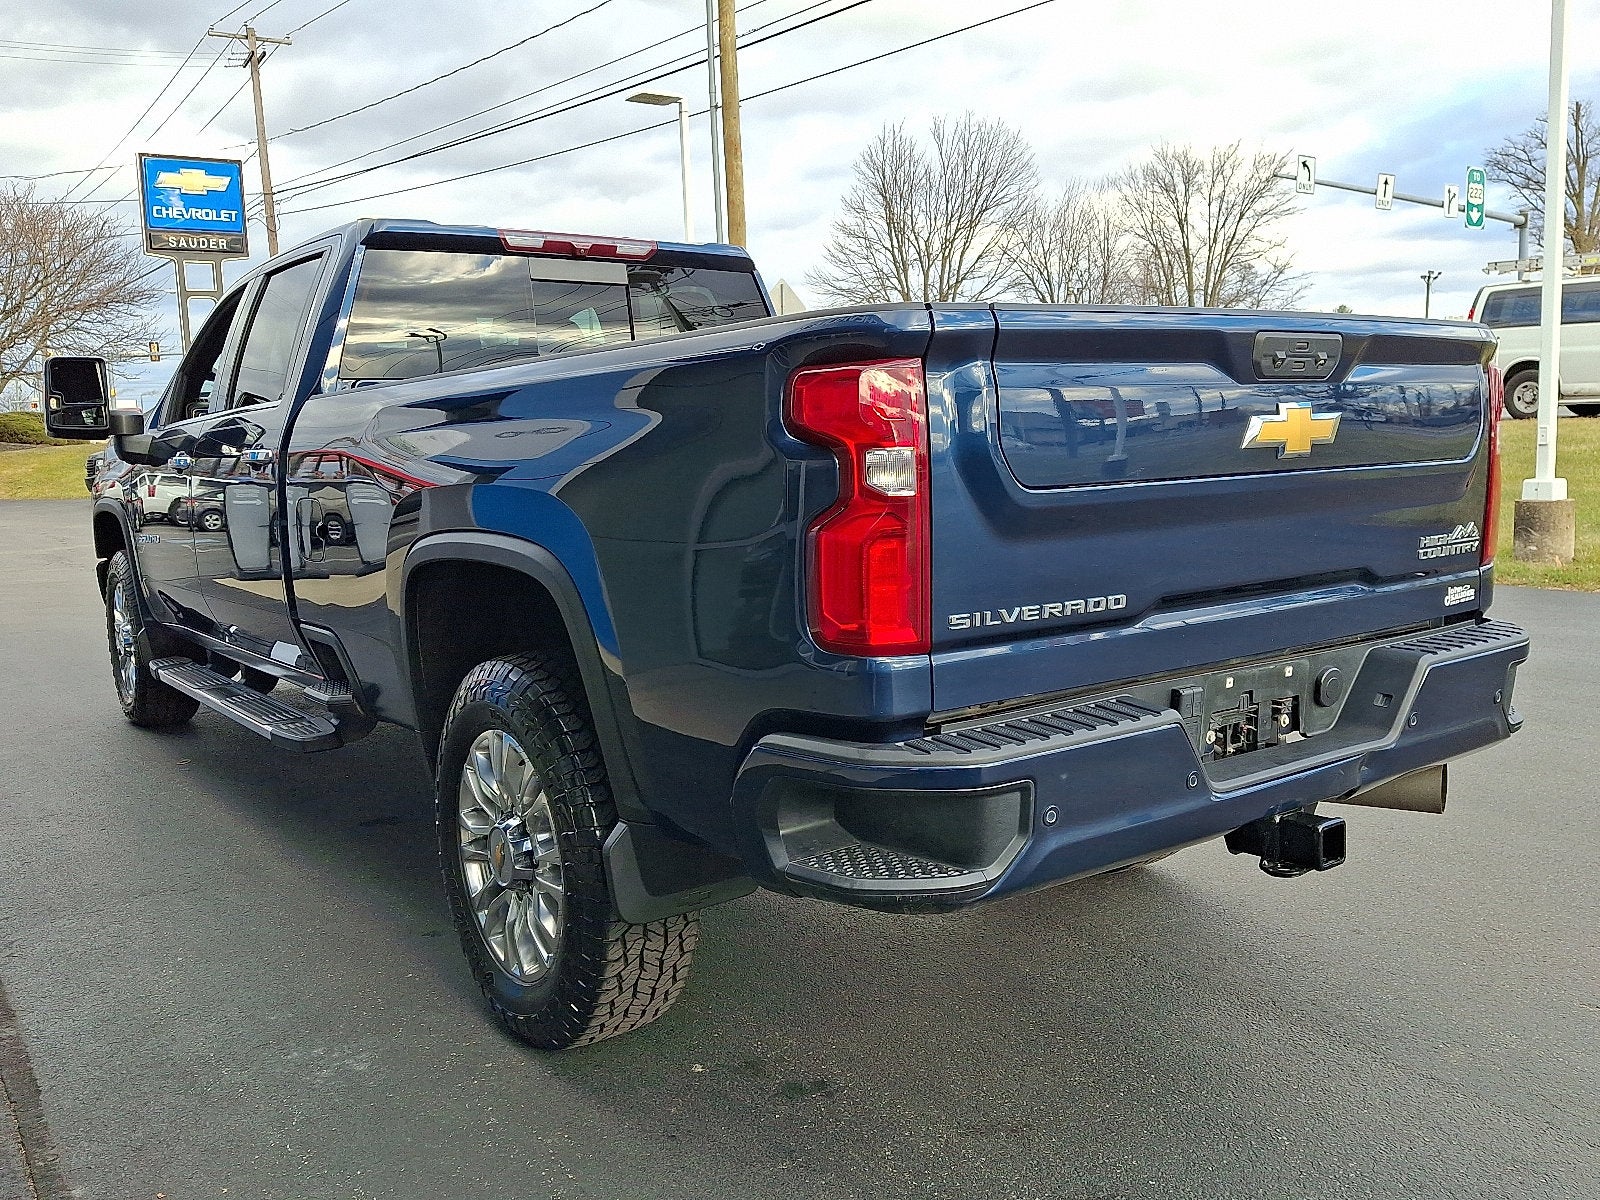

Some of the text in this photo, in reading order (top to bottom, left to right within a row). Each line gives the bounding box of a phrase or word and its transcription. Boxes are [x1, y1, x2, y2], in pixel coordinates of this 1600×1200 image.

[1472, 171, 1481, 181] TO
[1298, 183, 1312, 191] ONLY
[1469, 186, 1483, 200] 222
[1377, 199, 1390, 208] ONLY
[152, 205, 238, 221] CHEVROLET
[168, 236, 227, 250] SAUDER
[1420, 533, 1456, 547] HIGH
[1417, 541, 1479, 559] COUNTRY
[948, 594, 1127, 630] SILVERADO
